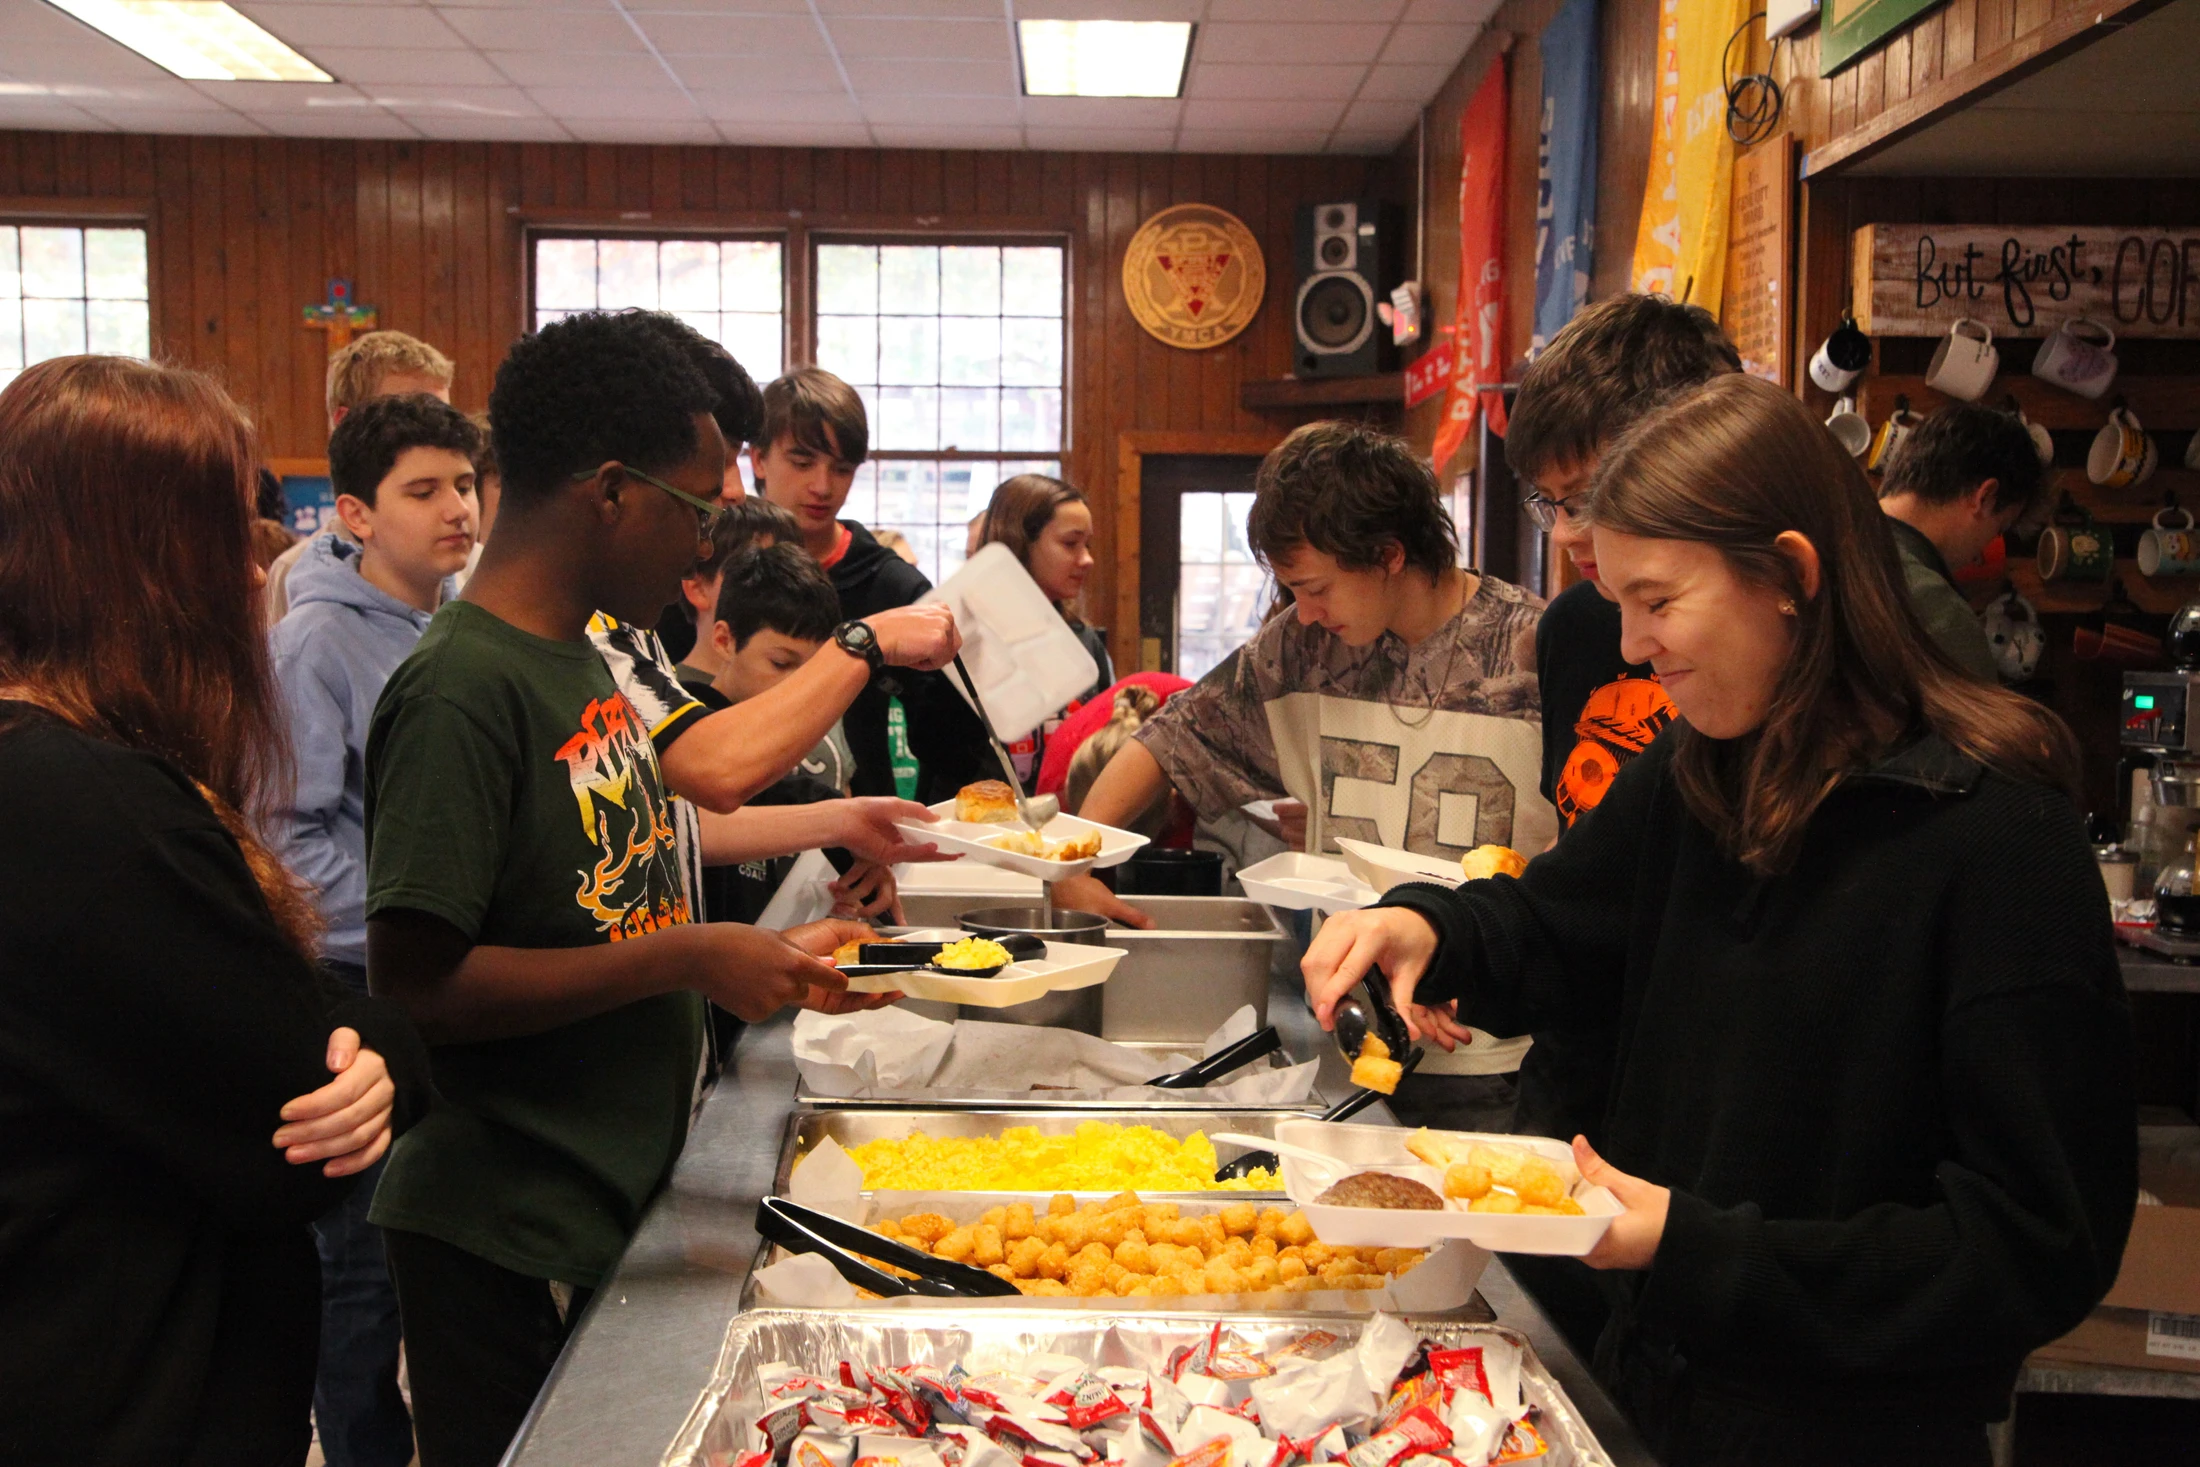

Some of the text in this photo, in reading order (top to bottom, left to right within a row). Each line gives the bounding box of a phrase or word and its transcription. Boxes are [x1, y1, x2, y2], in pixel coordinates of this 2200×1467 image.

[1916, 235, 1984, 309] But
[1996, 233, 2102, 328] first,
[1170, 325, 1227, 341] YMCA
[1320, 736, 1516, 865] 50
